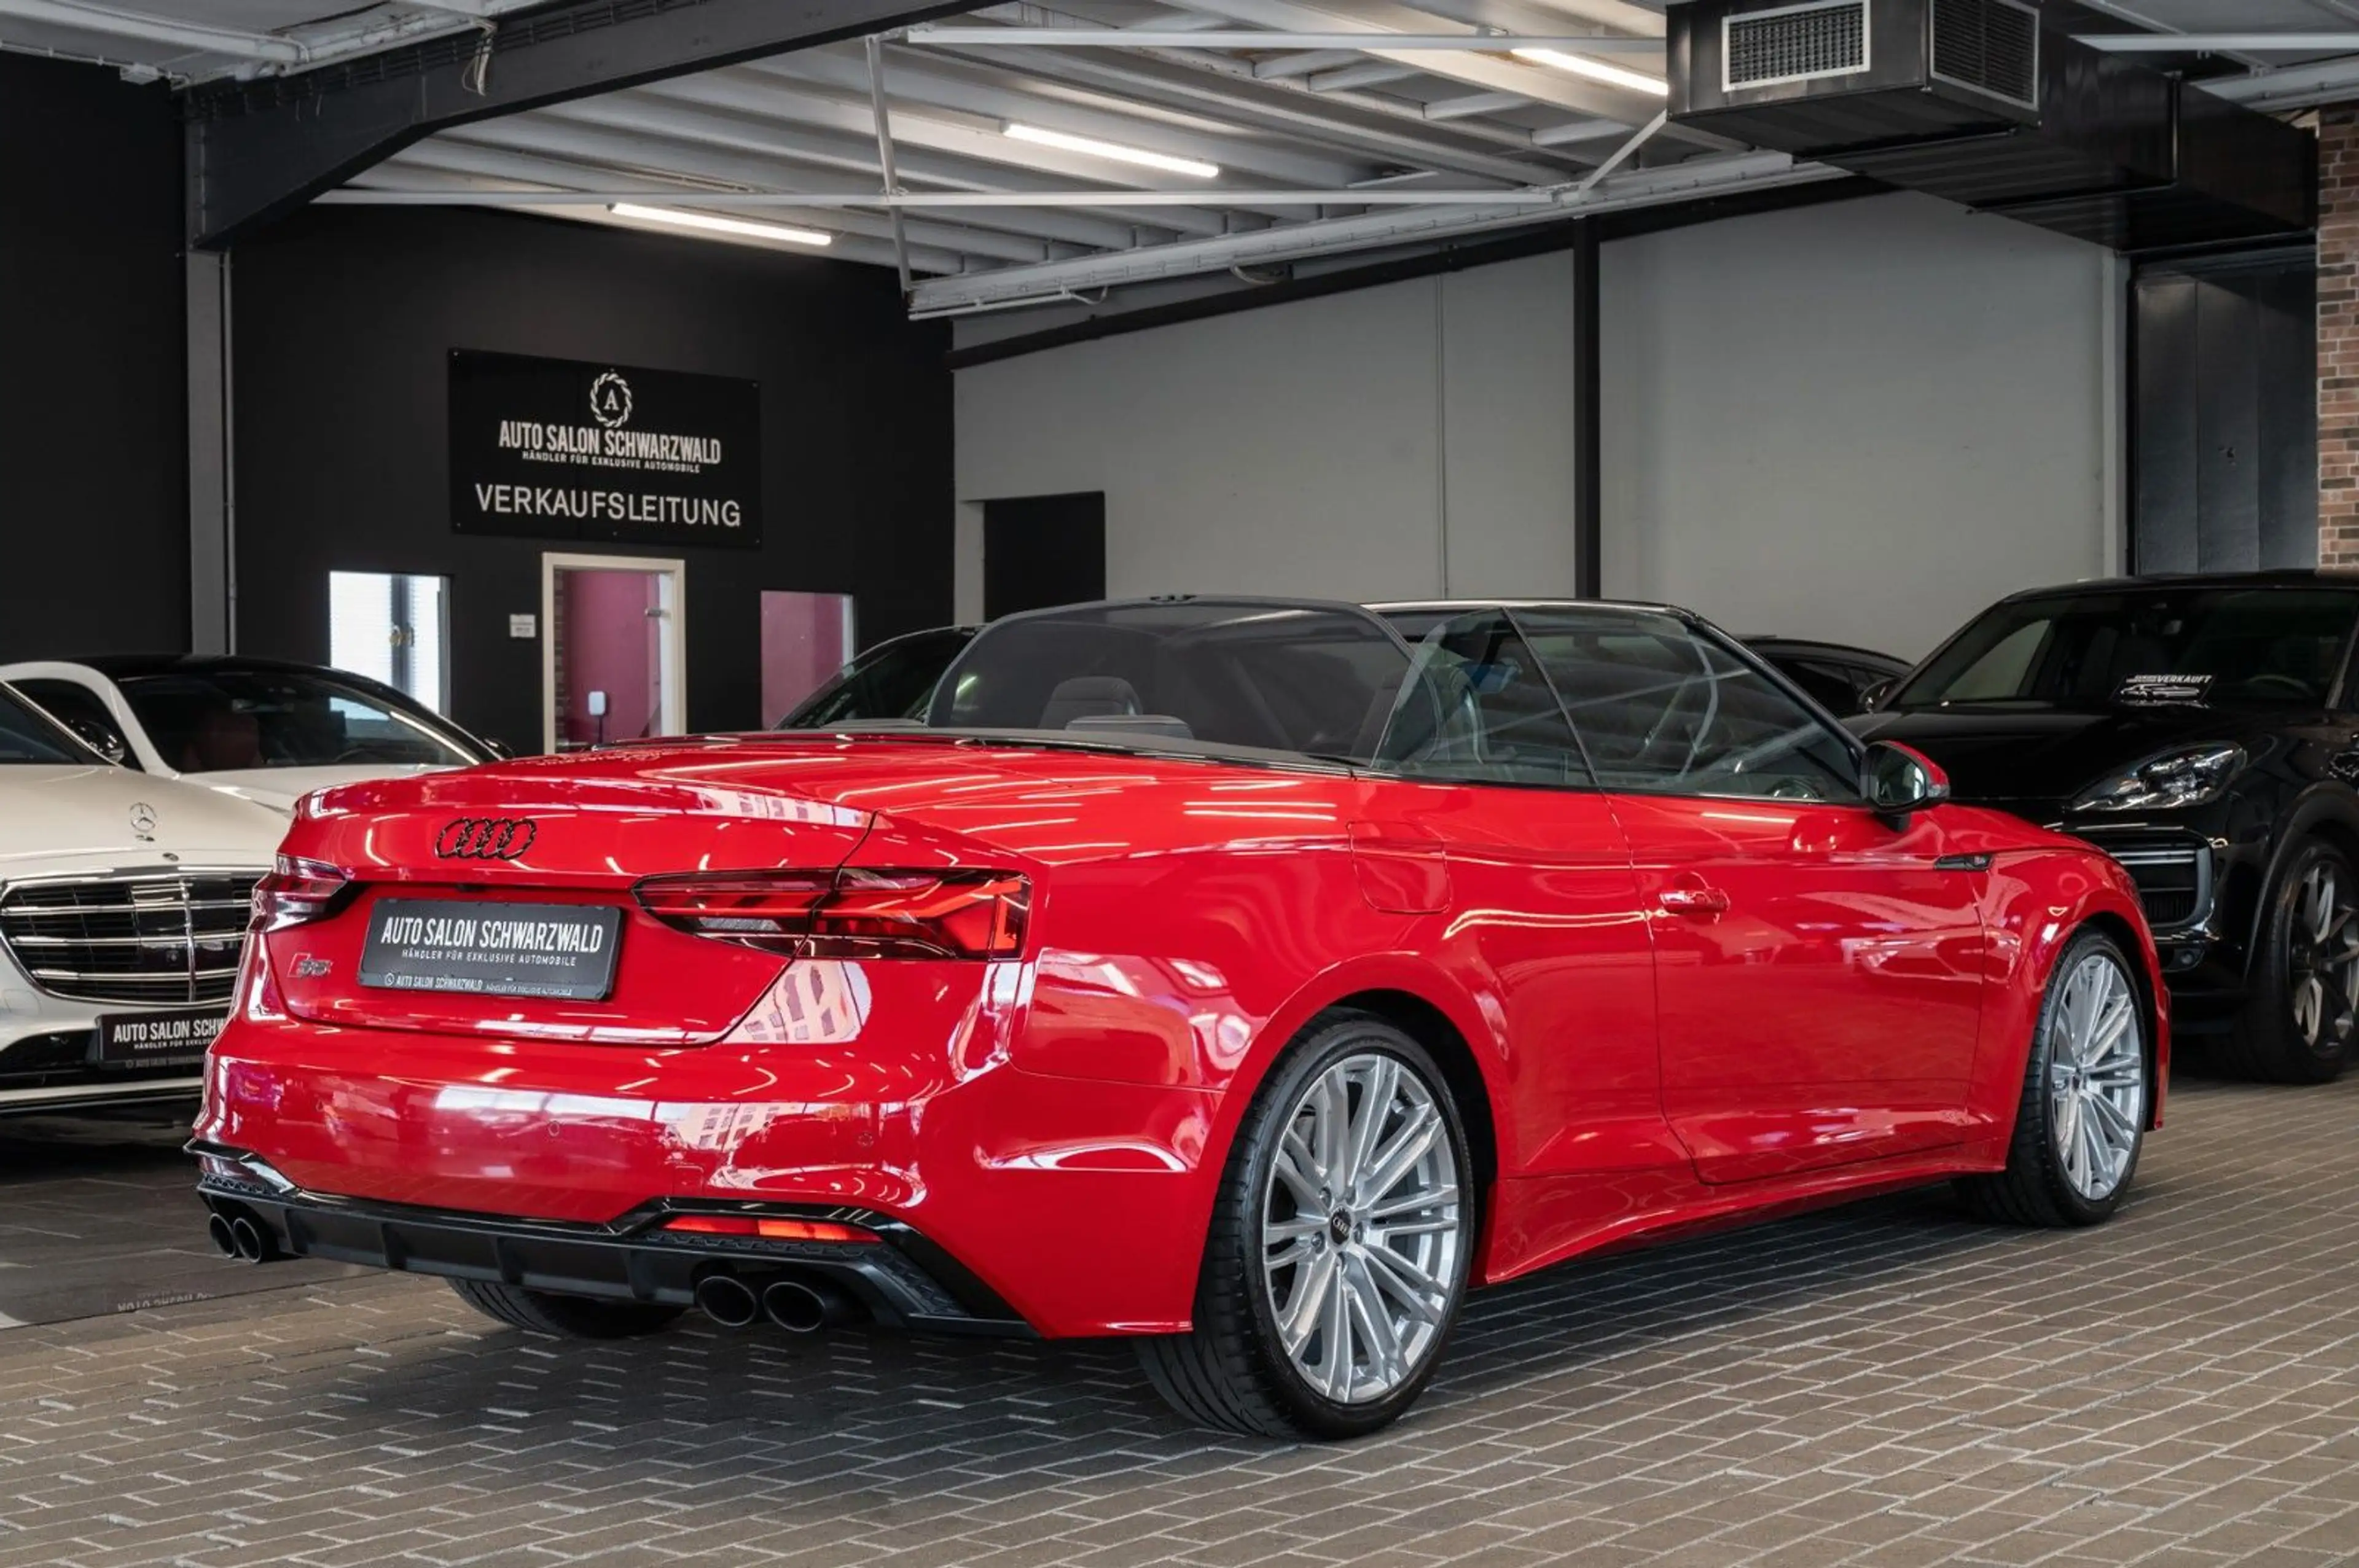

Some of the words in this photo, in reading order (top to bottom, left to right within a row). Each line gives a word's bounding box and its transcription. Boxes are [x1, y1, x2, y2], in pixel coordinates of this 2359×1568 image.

[498, 419, 543, 450] AUTO
[546, 424, 600, 455] SALON
[604, 429, 721, 465] SCHWARZWALD
[522, 449, 567, 463] HÄNDLER
[569, 453, 589, 465] FÜR
[591, 456, 641, 470] EXKLUSIVE
[644, 460, 701, 474] AUTOMOBILE
[475, 483, 741, 528] VERKAUFSLEITUNG
[380, 916, 423, 945] AUTO
[424, 918, 477, 947] SALON
[479, 920, 603, 953] SCHWARZWALD
[401, 947, 442, 960] HÄNDLER
[445, 950, 463, 962] FÜR
[467, 951, 515, 964] EXKLUSIVE
[518, 954, 577, 967] AUTOMOBILE
[113, 1023, 147, 1043] AUTO
[150, 1020, 189, 1040] SALON
